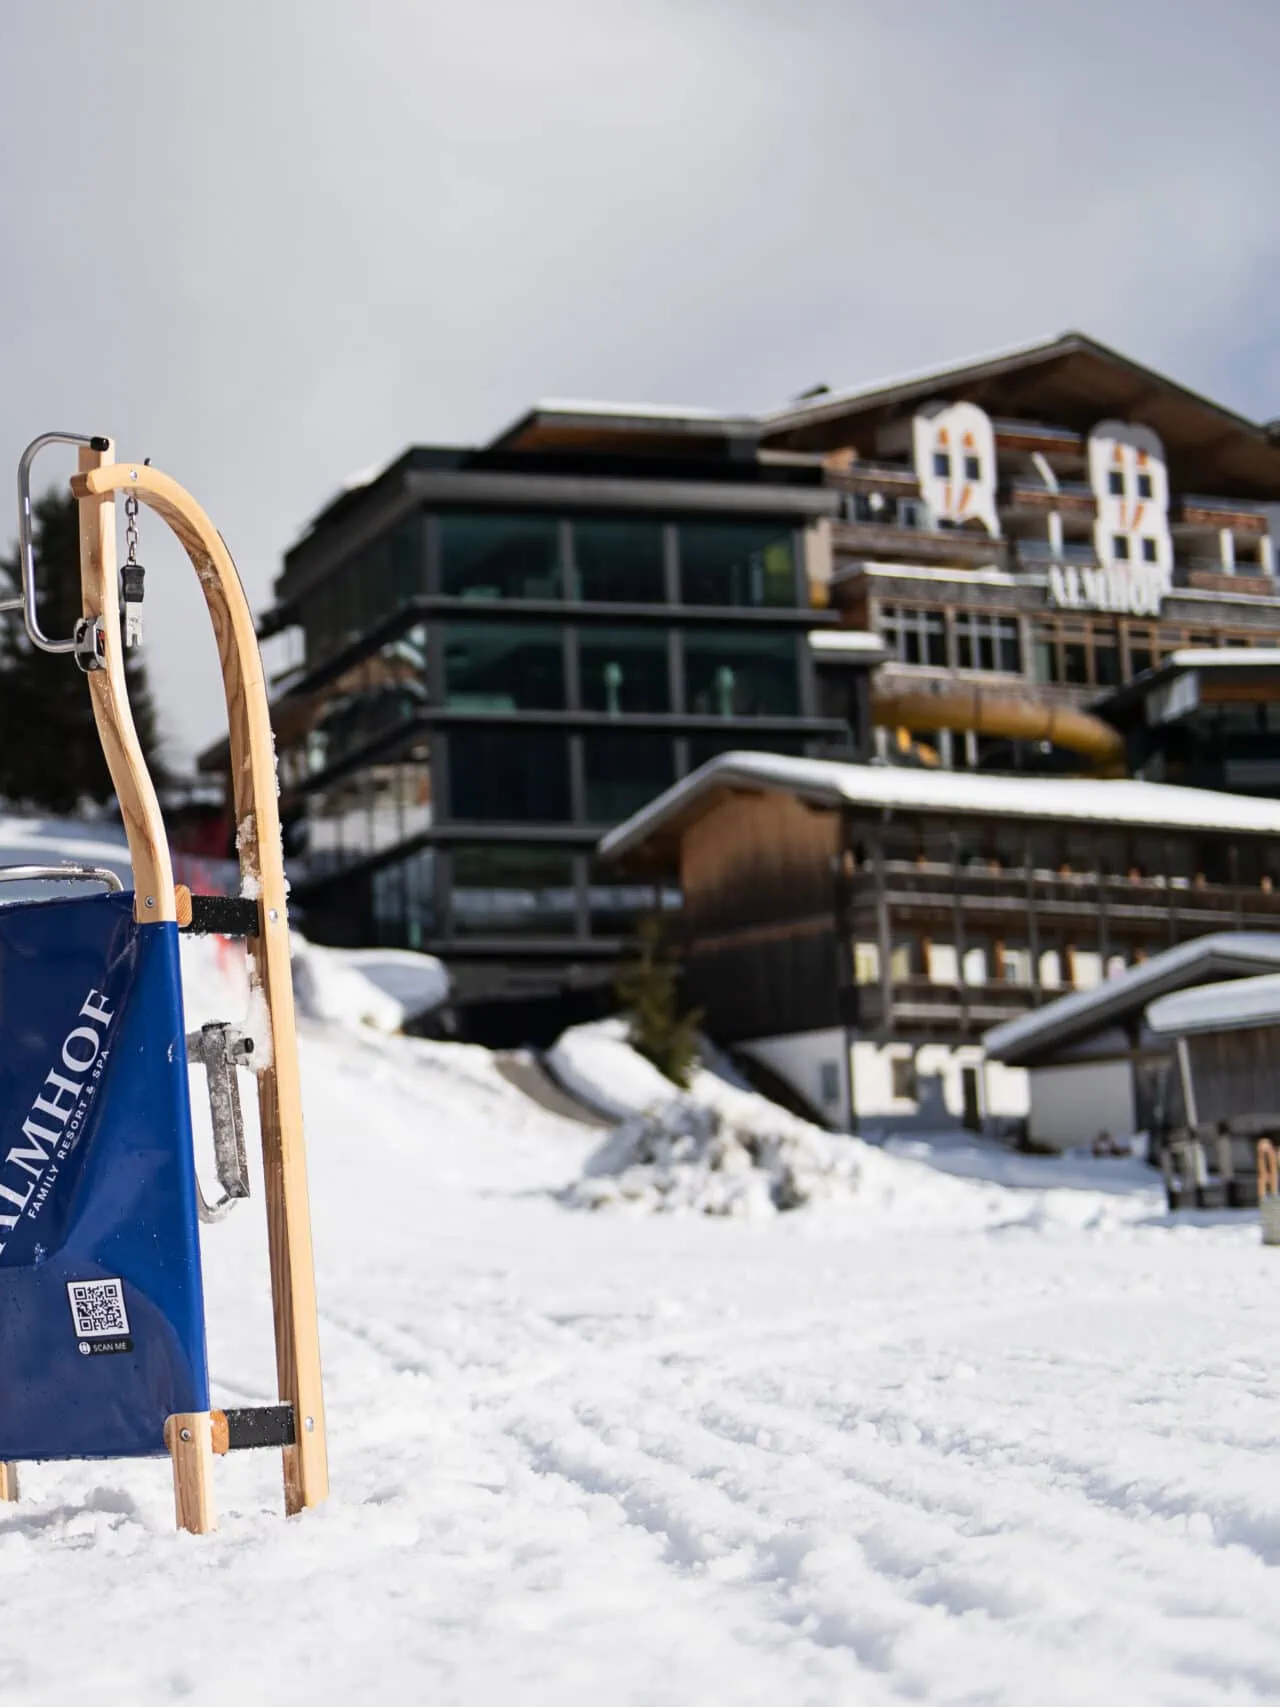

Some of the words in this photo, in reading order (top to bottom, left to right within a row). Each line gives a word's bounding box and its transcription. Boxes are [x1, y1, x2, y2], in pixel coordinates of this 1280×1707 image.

[28, 1164, 59, 1219] FAMILY
[57, 1101, 87, 1160] RESORT
[91, 1049, 110, 1078] SPA
[95, 1343, 114, 1352] SCAN
[115, 1341, 127, 1350] ME
